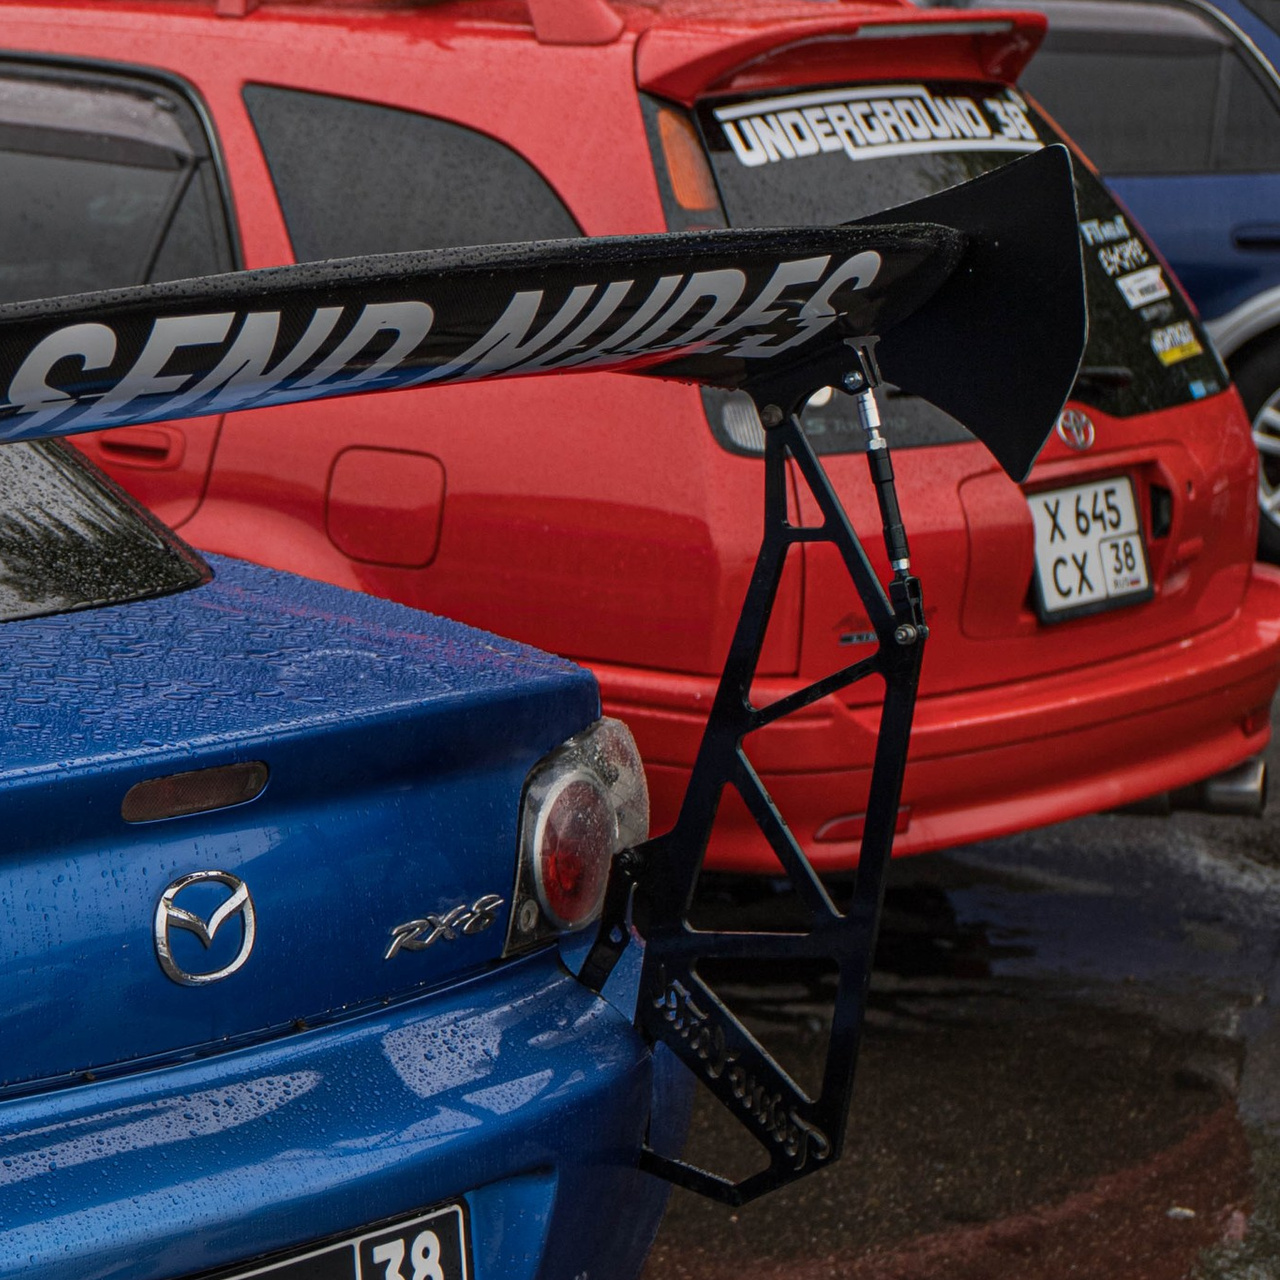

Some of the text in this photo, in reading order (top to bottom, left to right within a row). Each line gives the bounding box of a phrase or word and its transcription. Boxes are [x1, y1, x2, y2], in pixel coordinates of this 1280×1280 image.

[722, 93, 992, 167] UNDERGROUND
[405, 250, 883, 388] NUDES
[1075, 488, 1122, 537] 645
[1110, 541, 1136, 575] 38
[384, 893, 504, 960] RX-8
